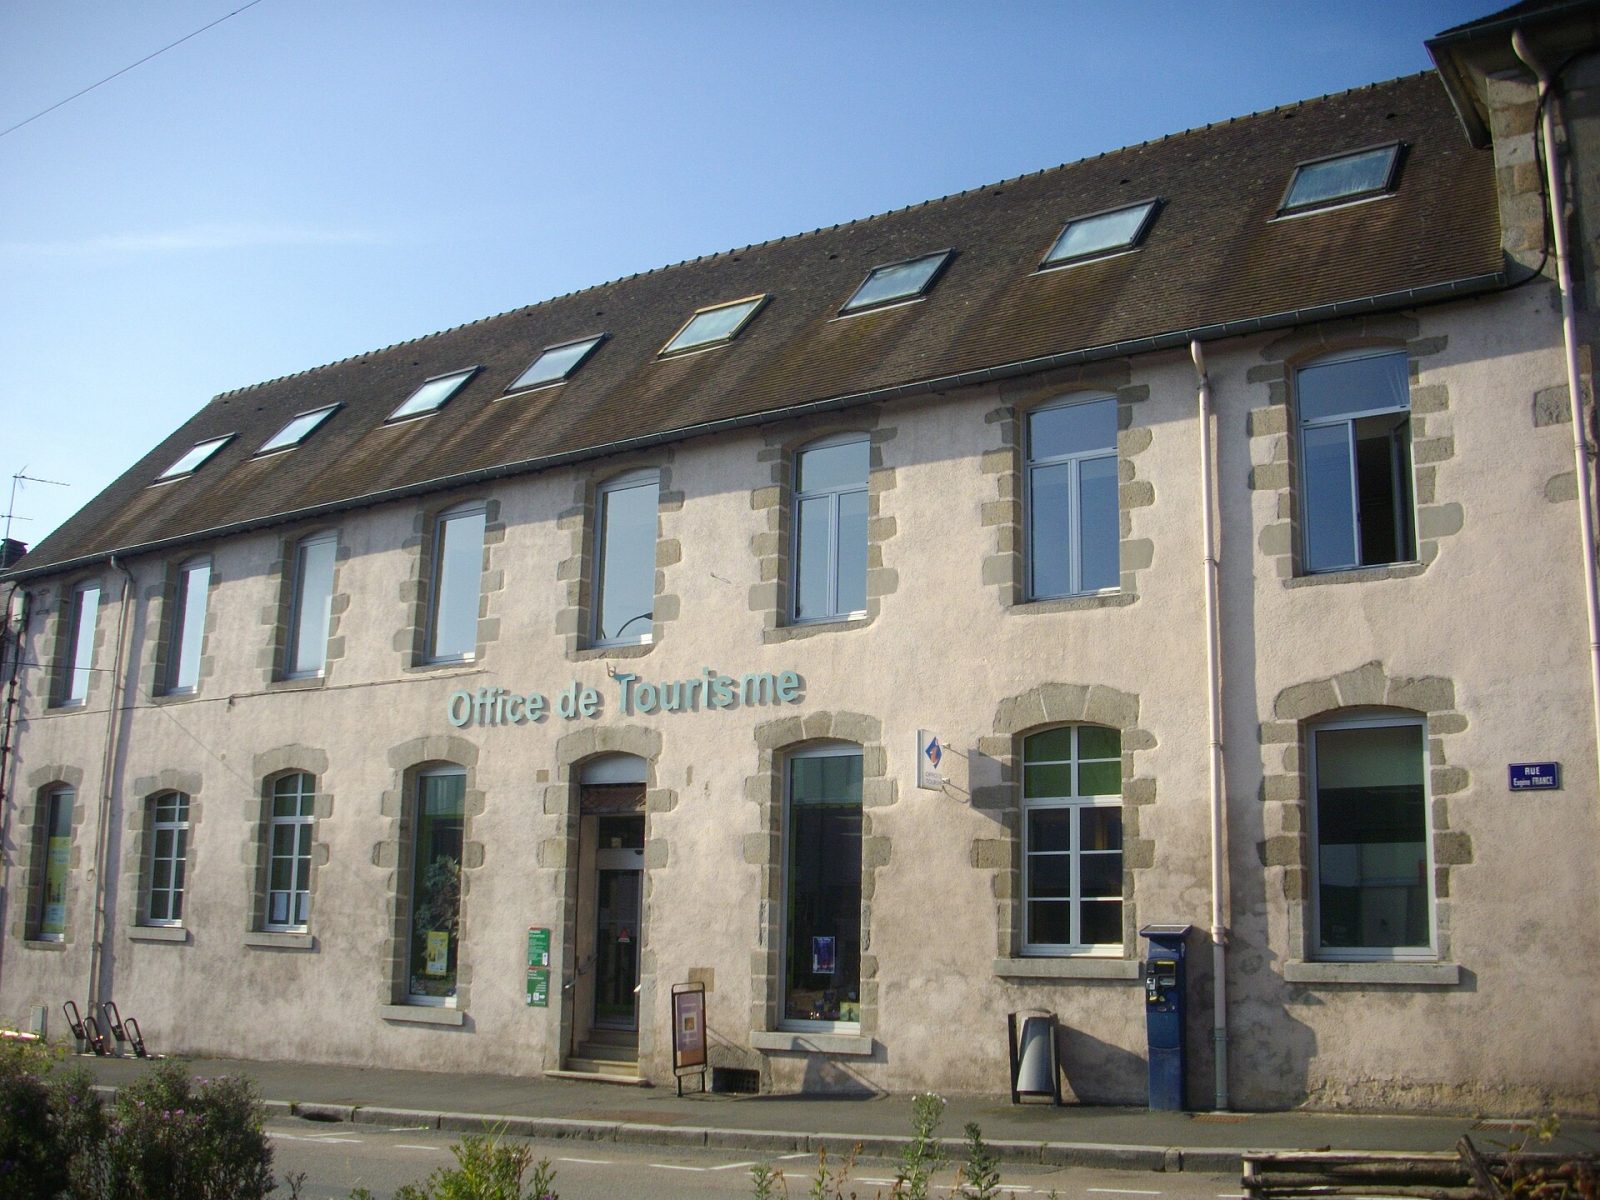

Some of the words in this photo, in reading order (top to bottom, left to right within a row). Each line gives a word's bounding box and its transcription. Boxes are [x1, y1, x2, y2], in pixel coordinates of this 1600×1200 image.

[447, 687, 544, 727] Office
[556, 679, 599, 719] de
[617, 667, 800, 714] Tourisme
[1524, 767, 1540, 775] RUE
